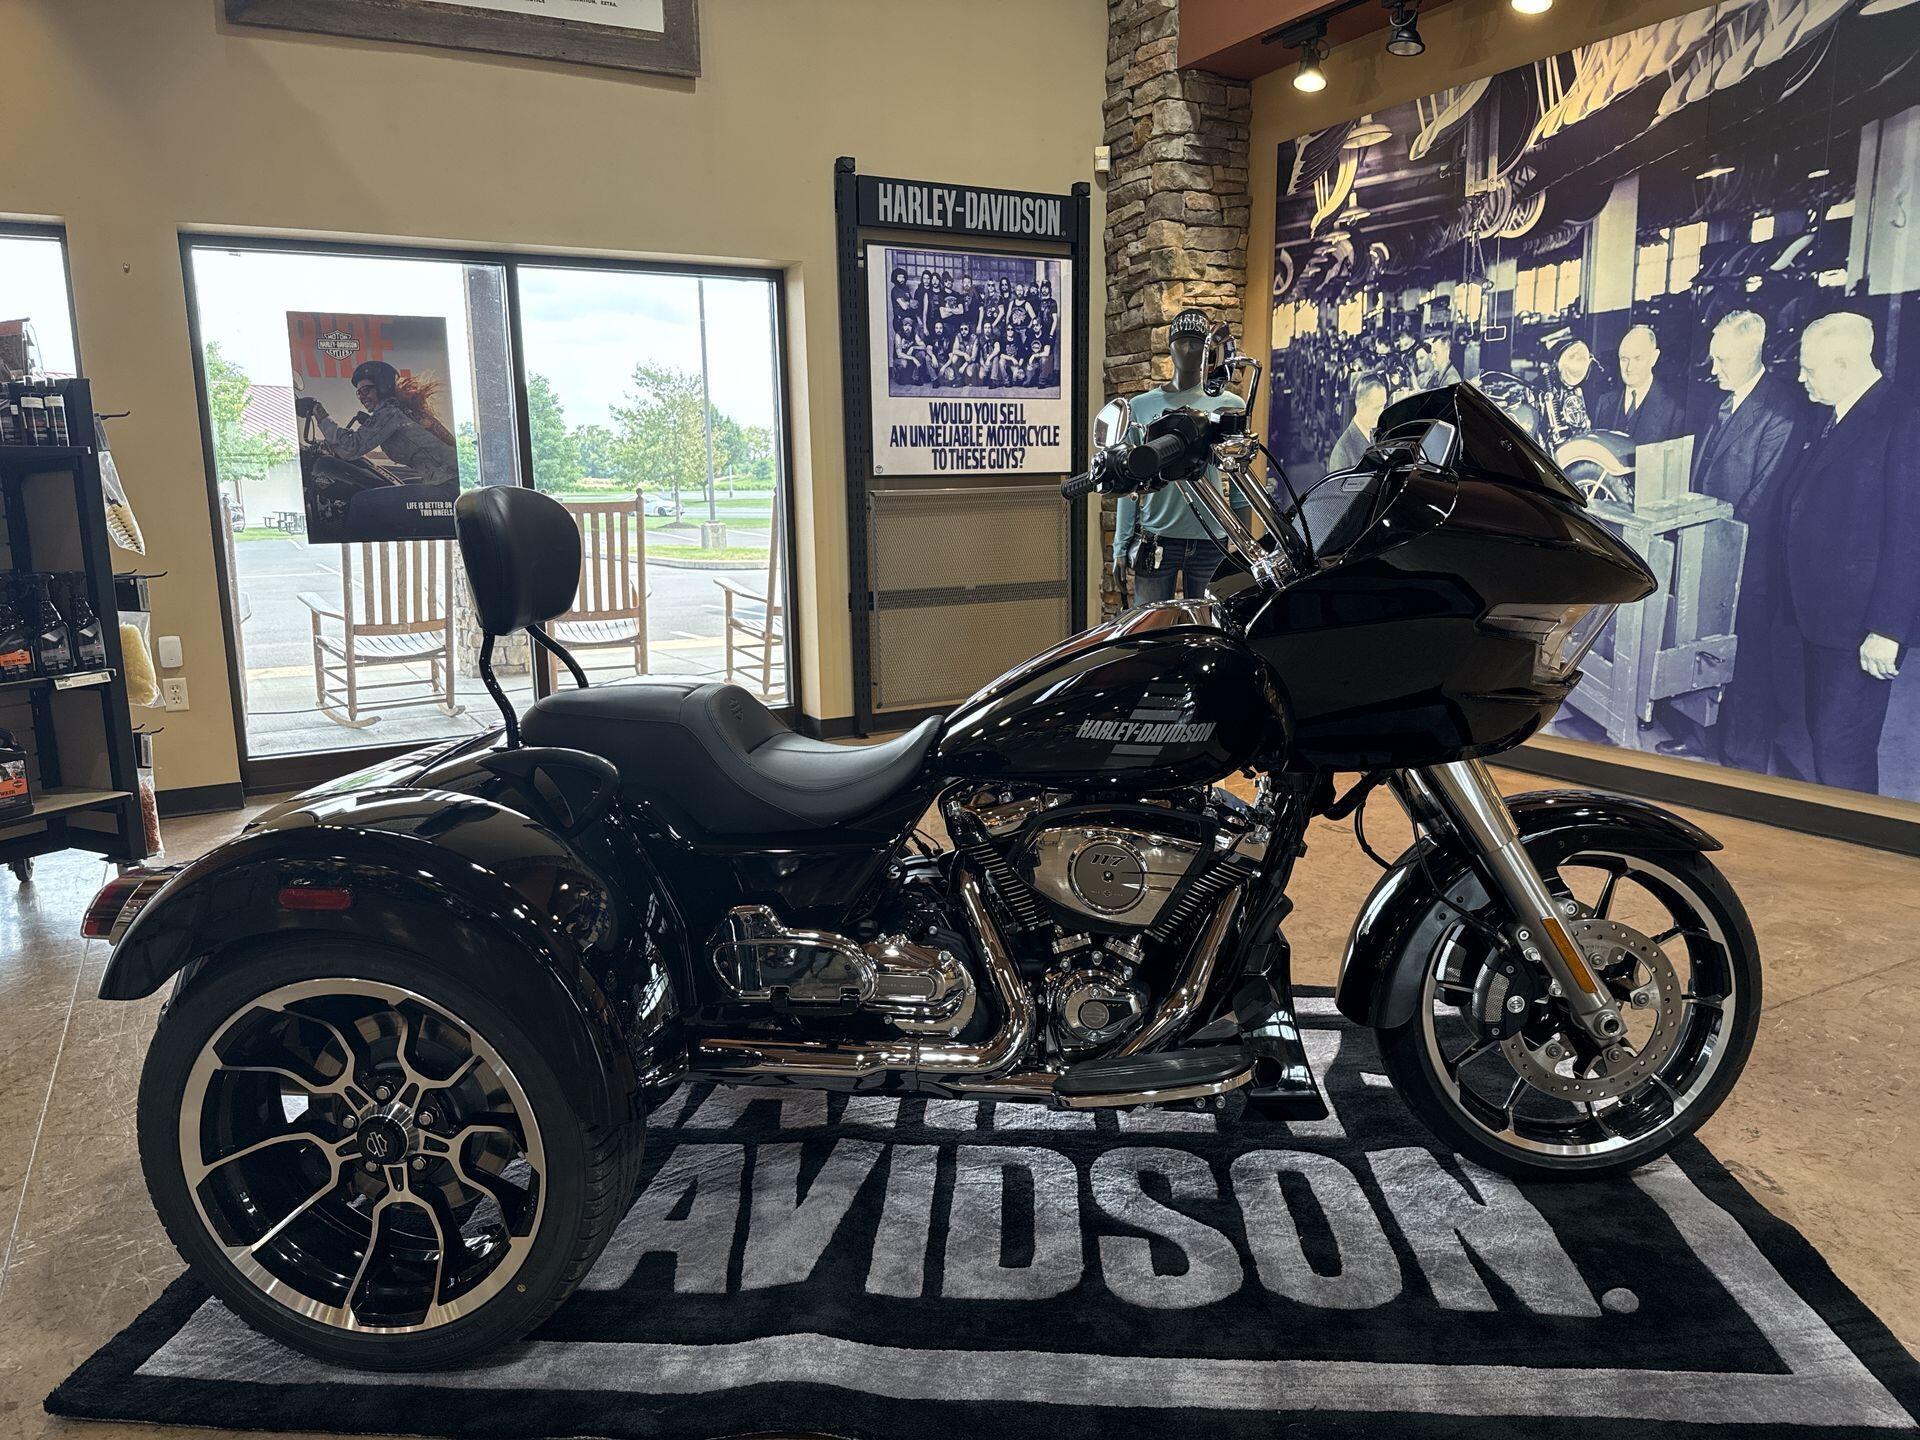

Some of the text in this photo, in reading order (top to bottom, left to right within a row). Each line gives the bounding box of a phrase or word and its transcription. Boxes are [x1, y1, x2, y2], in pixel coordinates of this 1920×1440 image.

[878, 183, 1061, 236] HARLEY-DAVIDSON
[929, 402, 1026, 424] WOULD YOU SELL
[890, 425, 1060, 447] AN UNRELIABLE MOTORCYCLE
[932, 447, 1026, 470] TO THESE GUYS?
[425, 501, 444, 509] BETTER
[1076, 719, 1216, 743] HARLEY-DAVIDSON
[1091, 853, 1128, 867] 117
[578, 1143, 1639, 1317] AVIDSON.
